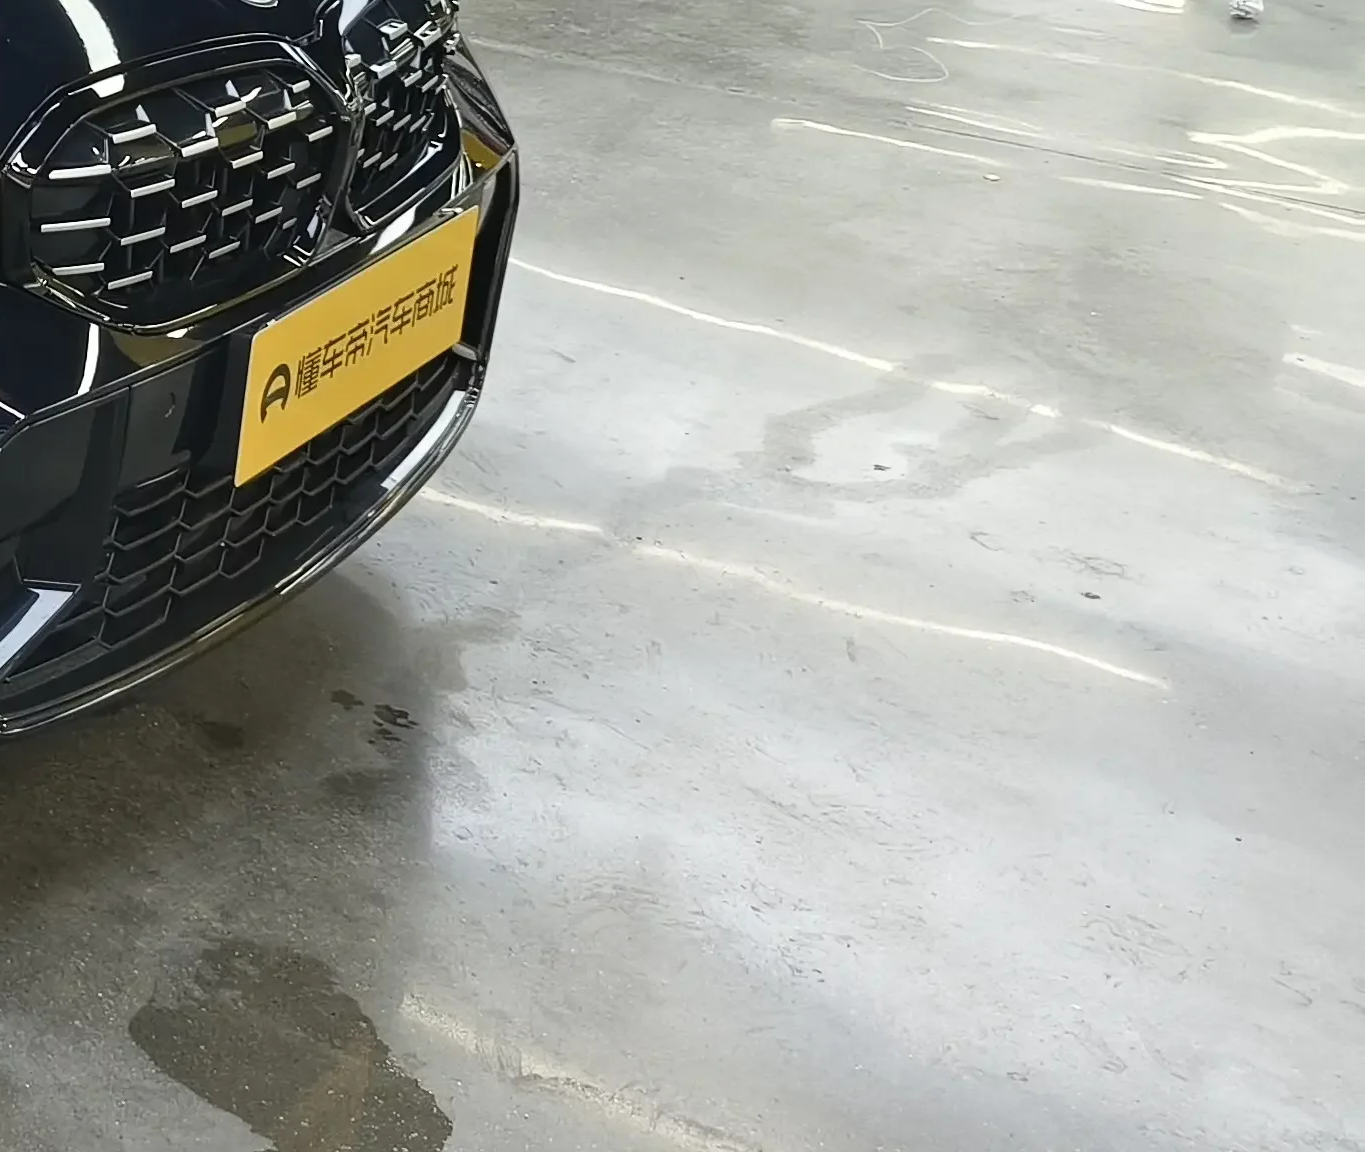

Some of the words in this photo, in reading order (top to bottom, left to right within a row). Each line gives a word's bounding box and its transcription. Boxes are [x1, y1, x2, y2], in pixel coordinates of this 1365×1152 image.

[294, 264, 459, 400] 懂车帝汽车商城
